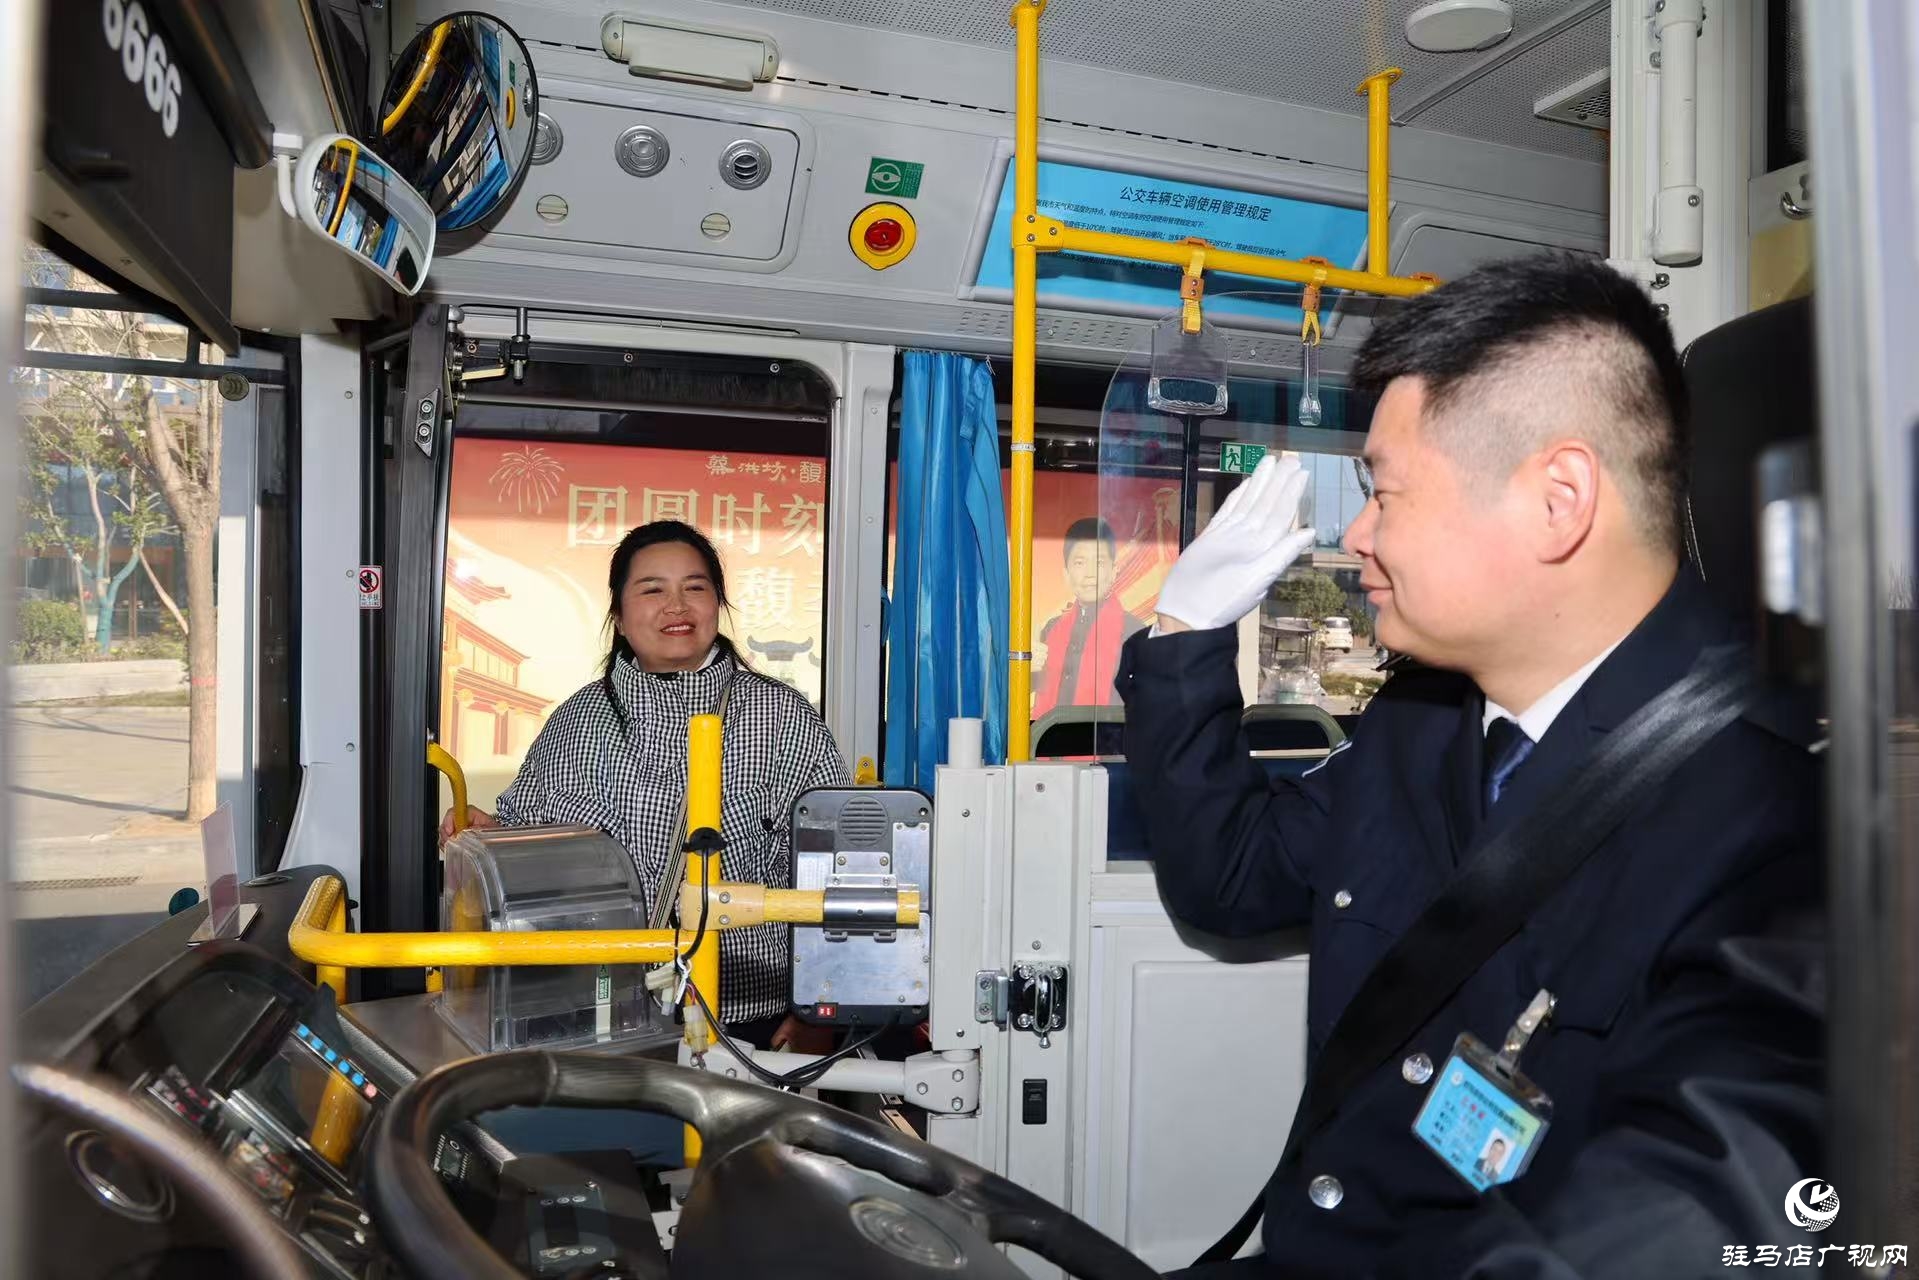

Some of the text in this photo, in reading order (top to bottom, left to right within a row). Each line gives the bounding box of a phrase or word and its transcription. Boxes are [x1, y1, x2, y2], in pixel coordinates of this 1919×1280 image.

[1120, 187, 1271, 221] 公交车辆空调使用管理规定
[568, 484, 824, 557] 团圆时刻
